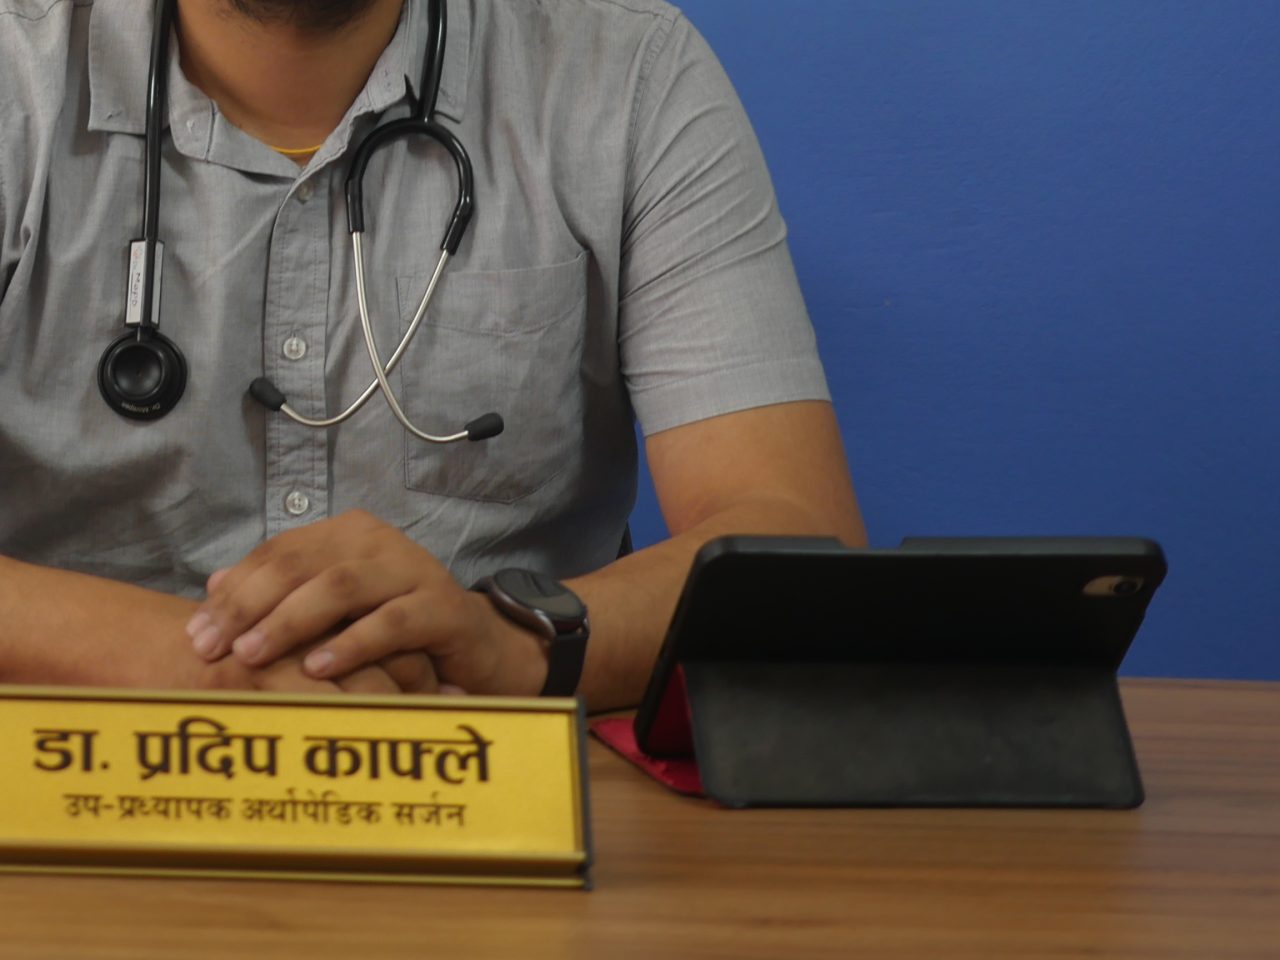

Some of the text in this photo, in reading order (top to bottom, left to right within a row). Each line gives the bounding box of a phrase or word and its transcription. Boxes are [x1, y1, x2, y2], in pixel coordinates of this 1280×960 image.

[34, 716, 493, 784] डा. प्रदिप काफ्ले
[391, 791, 467, 827] सर्जन
